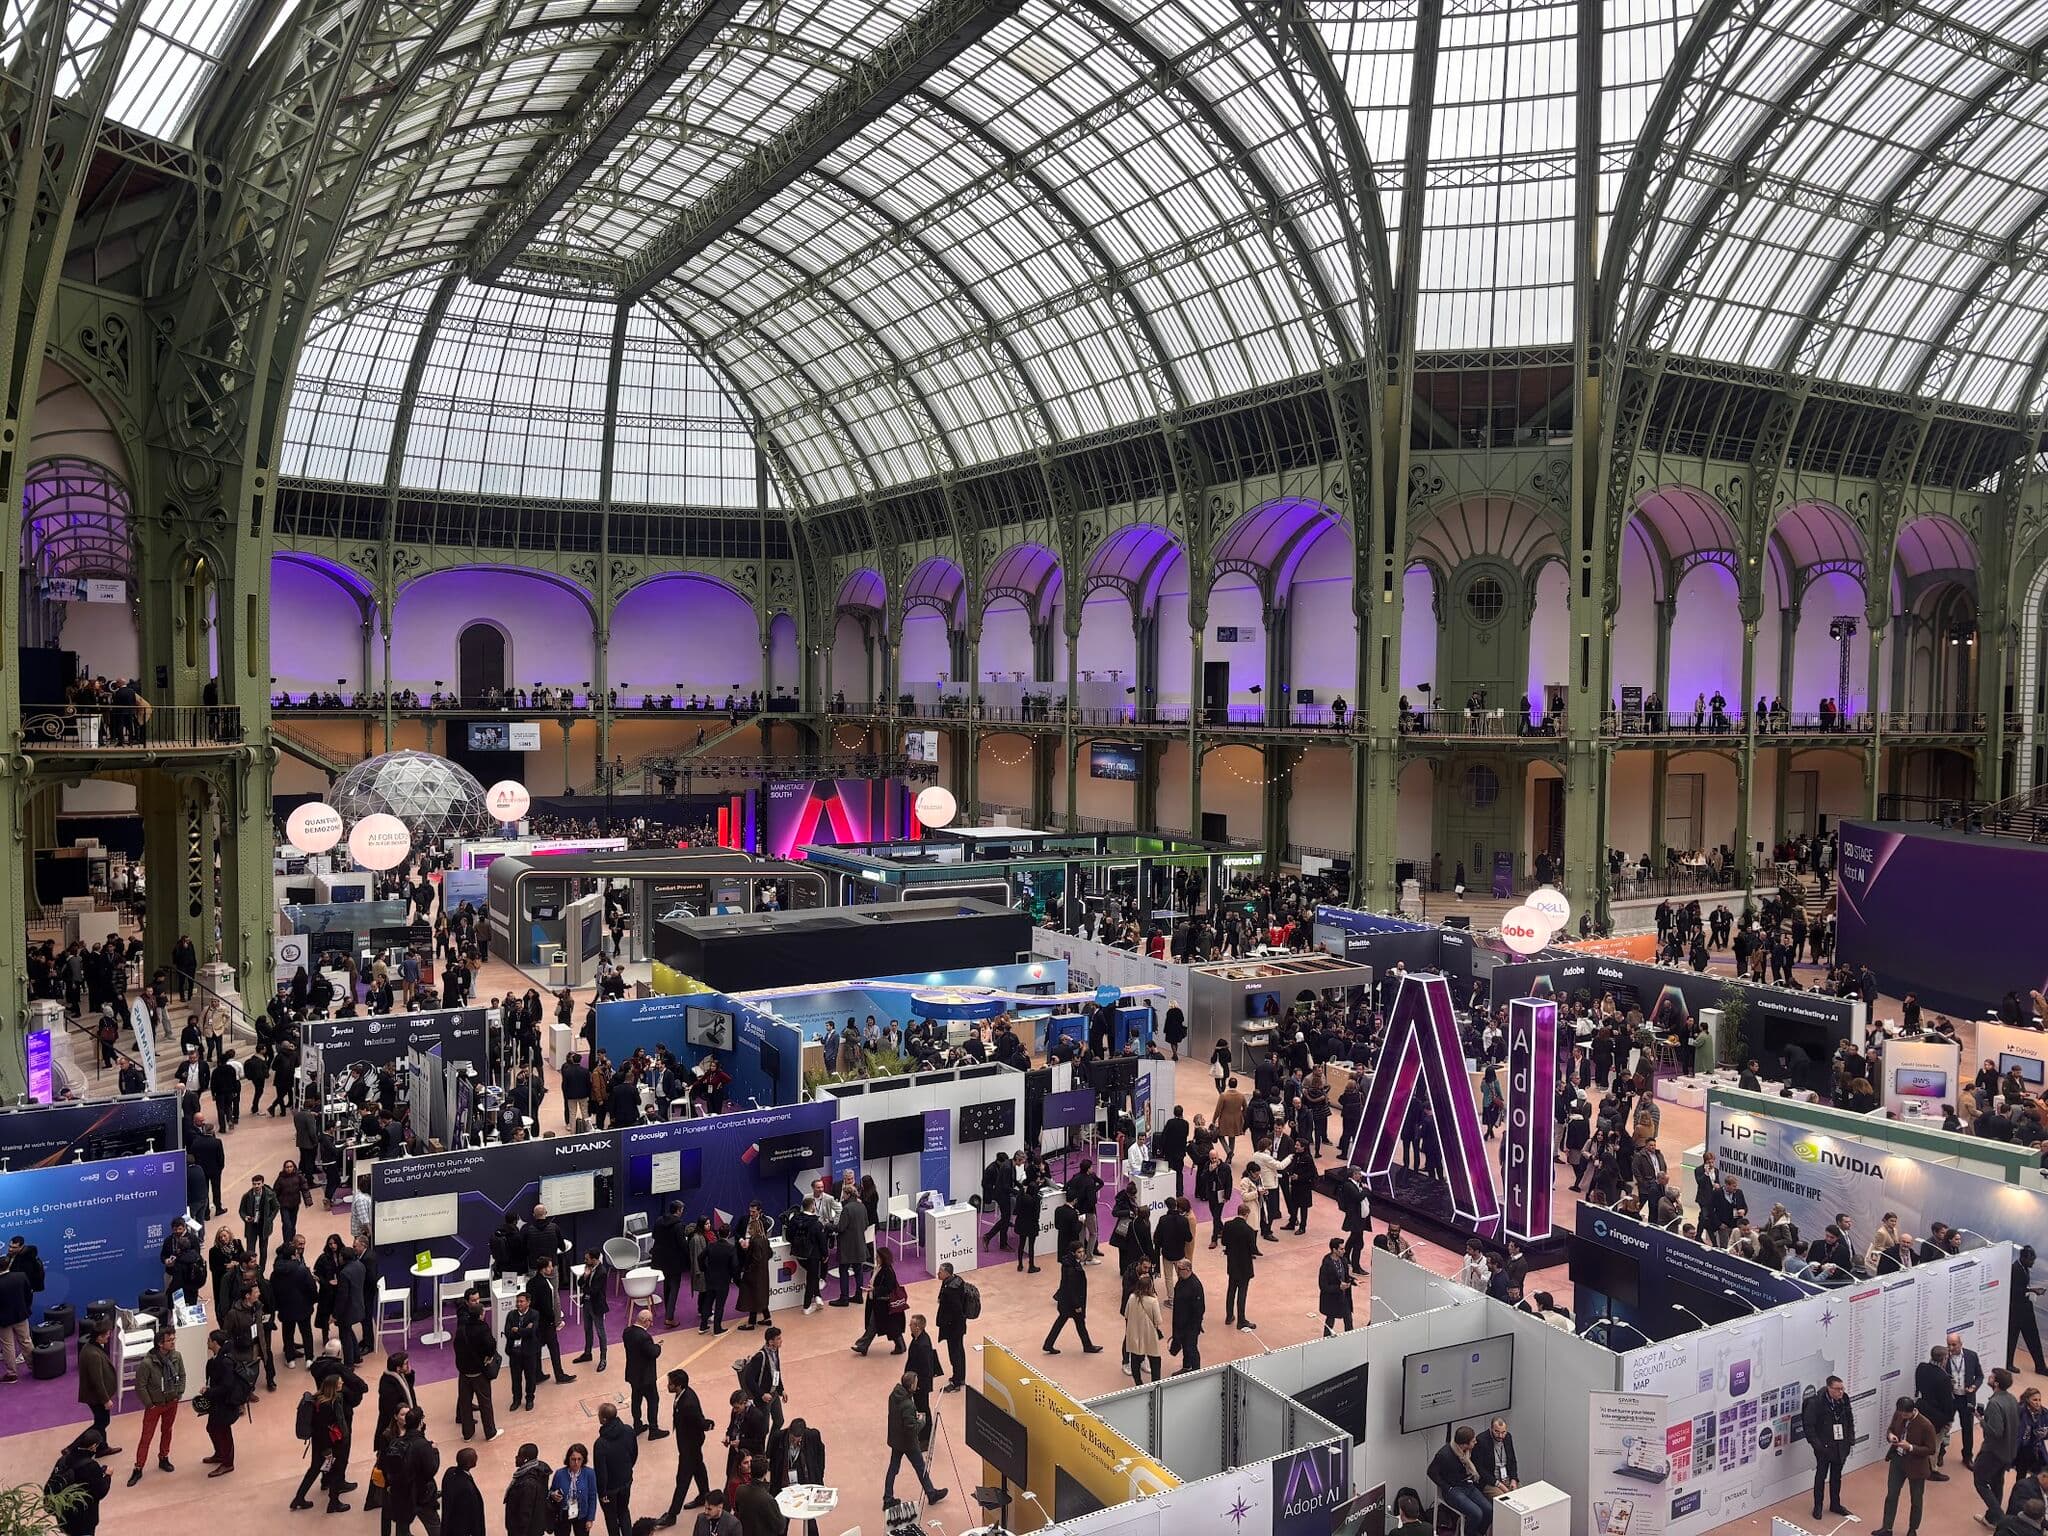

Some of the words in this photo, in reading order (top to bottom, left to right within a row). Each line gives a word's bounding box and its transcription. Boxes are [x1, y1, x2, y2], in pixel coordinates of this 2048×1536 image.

[1223, 858, 1253, 866] aramco
[1854, 845, 1874, 864] STAGE
[1537, 902, 1565, 914] DELL
[1563, 966, 1585, 976] Adobe
[1597, 966, 1624, 979] Adobe
[648, 1003, 681, 1012] OUTSCALE
[1757, 1000, 1787, 1013] Creativity
[1793, 1007, 1825, 1020] Marketing
[1830, 1014, 1839, 1022] AI
[330, 1026, 354, 1037] Jaydai
[1912, 1077, 1931, 1085] aws
[638, 1131, 668, 1141] docusign
[682, 1125, 708, 1135] Pioneer
[709, 1123, 716, 1131] in
[716, 1120, 747, 1130] Contract
[747, 1113, 792, 1125] Management
[1512, 1027, 1530, 1208] Adopt
[1719, 1120, 1768, 1147] HPE
[555, 1140, 612, 1156] NUTANIX
[384, 1167, 402, 1176] One
[402, 1162, 435, 1174] Platform
[447, 1159, 462, 1167] Run
[464, 1156, 485, 1165] Apps,
[1719, 1146, 1748, 1165] UNLOCK
[1750, 1155, 1796, 1178] INNOVATION
[384, 1174, 405, 1185] Data,
[406, 1172, 422, 1181] and
[423, 1171, 431, 1179] AI
[432, 1165, 473, 1178] Anywhere.
[1718, 1160, 1743, 1177] NVIDIA
[1743, 1170, 1751, 1180] AI
[1751, 1172, 1795, 1194] COMPUTING
[1795, 1184, 1806, 1197] BY
[1806, 1187, 1822, 1201] HPE
[32, 1204, 40, 1213] &
[42, 1196, 113, 1213] Orchestration
[115, 1189, 158, 1202] Platform
[25, 1217, 44, 1225] scale
[1609, 1228, 1650, 1250] ringover
[939, 1246, 974, 1260] turbotic
[1672, 1249, 1704, 1267] plateforme
[1704, 1261, 1713, 1269] de
[1712, 1264, 1760, 1287] communication
[1751, 1289, 1762, 1298] par
[1632, 1363, 1664, 1380] GROUND
[1664, 1354, 1687, 1370] FLOOR
[1633, 1353, 1658, 1368] ADOPT
[1633, 1378, 1650, 1391] MAP
[1080, 1423, 1089, 1437] &
[1088, 1429, 1117, 1460] Biases
[1080, 1441, 1088, 1453] by
[1724, 1489, 1749, 1501] ENTRANCE
[1283, 1494, 1323, 1519] Adopt
[1344, 1502, 1377, 1525] neovision
